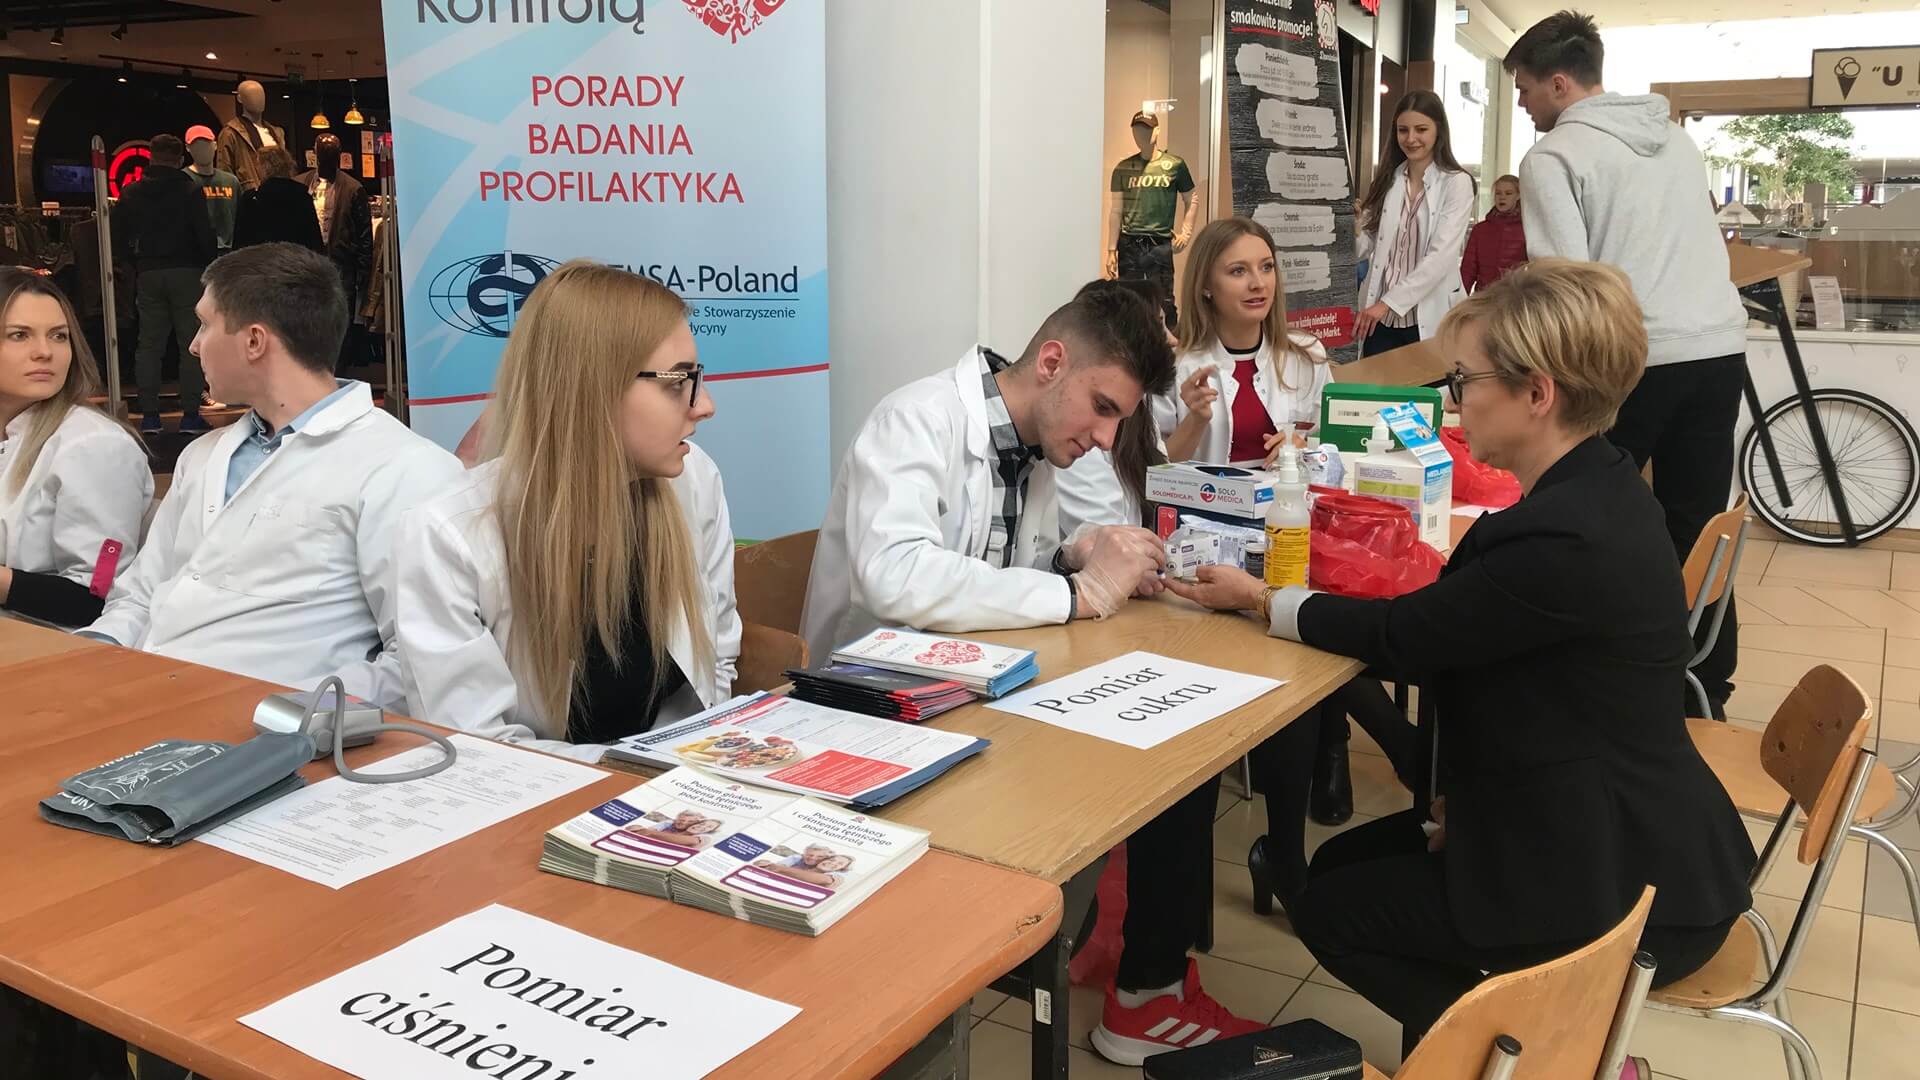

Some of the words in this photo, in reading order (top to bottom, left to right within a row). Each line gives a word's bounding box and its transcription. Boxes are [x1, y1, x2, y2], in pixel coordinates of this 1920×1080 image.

[1230, 9, 1276, 29] smakowite
[1277, 20, 1313, 38] promocje!
[531, 75, 685, 107] PORADY
[528, 123, 693, 155] BADANIA
[479, 171, 744, 203] PROFILAKTYKA
[704, 306, 796, 320] Stowarzyszenie
[1217, 495, 1244, 505] MEDICA
[1218, 487, 1237, 497] SOLO
[1031, 666, 1167, 715] Pomiar
[1117, 680, 1218, 722] cukru
[678, 791, 700, 801] pod
[690, 780, 722, 795] Poziom
[801, 823, 825, 833] pod
[824, 830, 864, 846] kontrolą
[812, 811, 847, 827] Poziom
[848, 823, 886, 838] glukozy
[440, 942, 668, 1041] Pomiar
